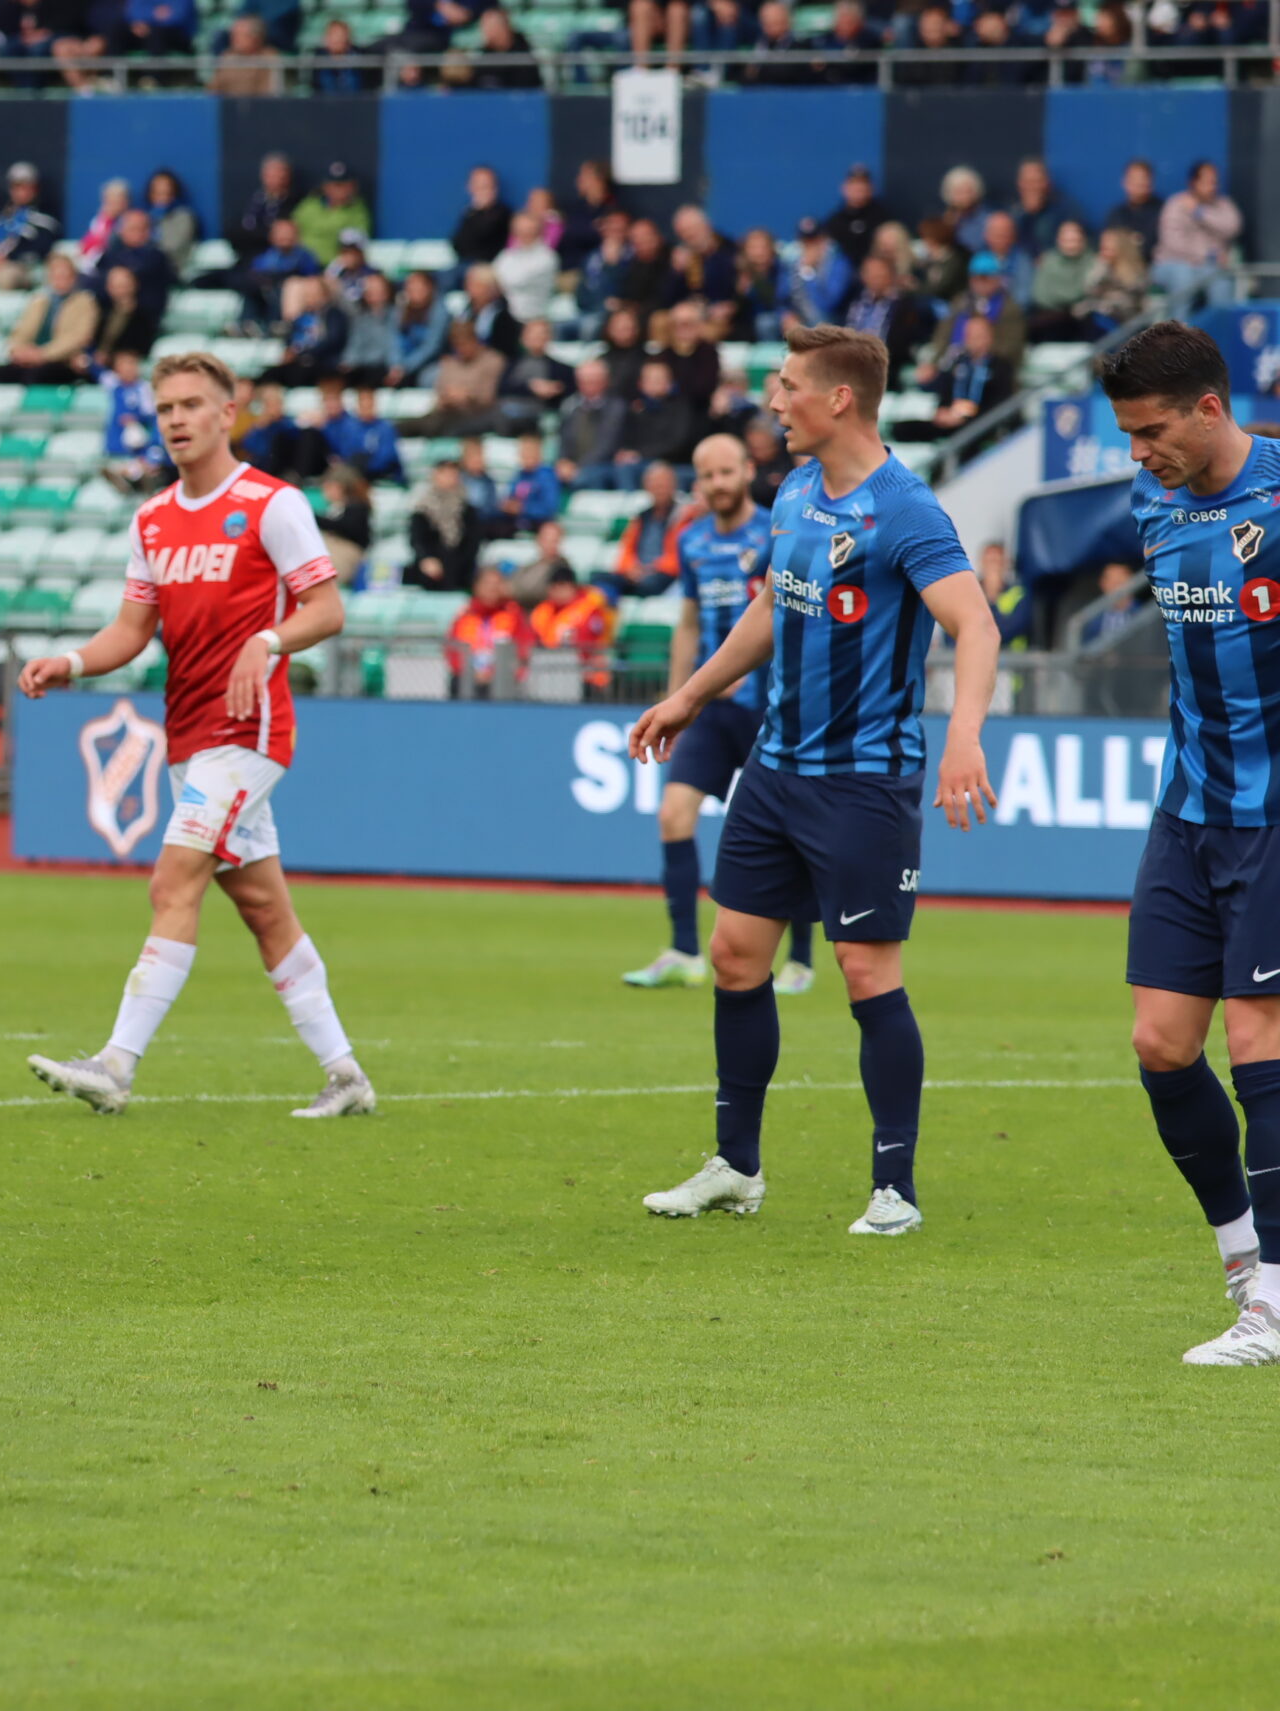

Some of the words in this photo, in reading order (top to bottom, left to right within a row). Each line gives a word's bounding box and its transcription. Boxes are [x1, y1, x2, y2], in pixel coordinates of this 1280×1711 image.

[813, 511, 837, 527] OBOS
[1189, 508, 1228, 523] OBOS
[147, 543, 239, 586] MAPEI
[838, 590, 854, 616] 1
[1252, 586, 1271, 614] 1
[1160, 607, 1236, 623] STLANDET
